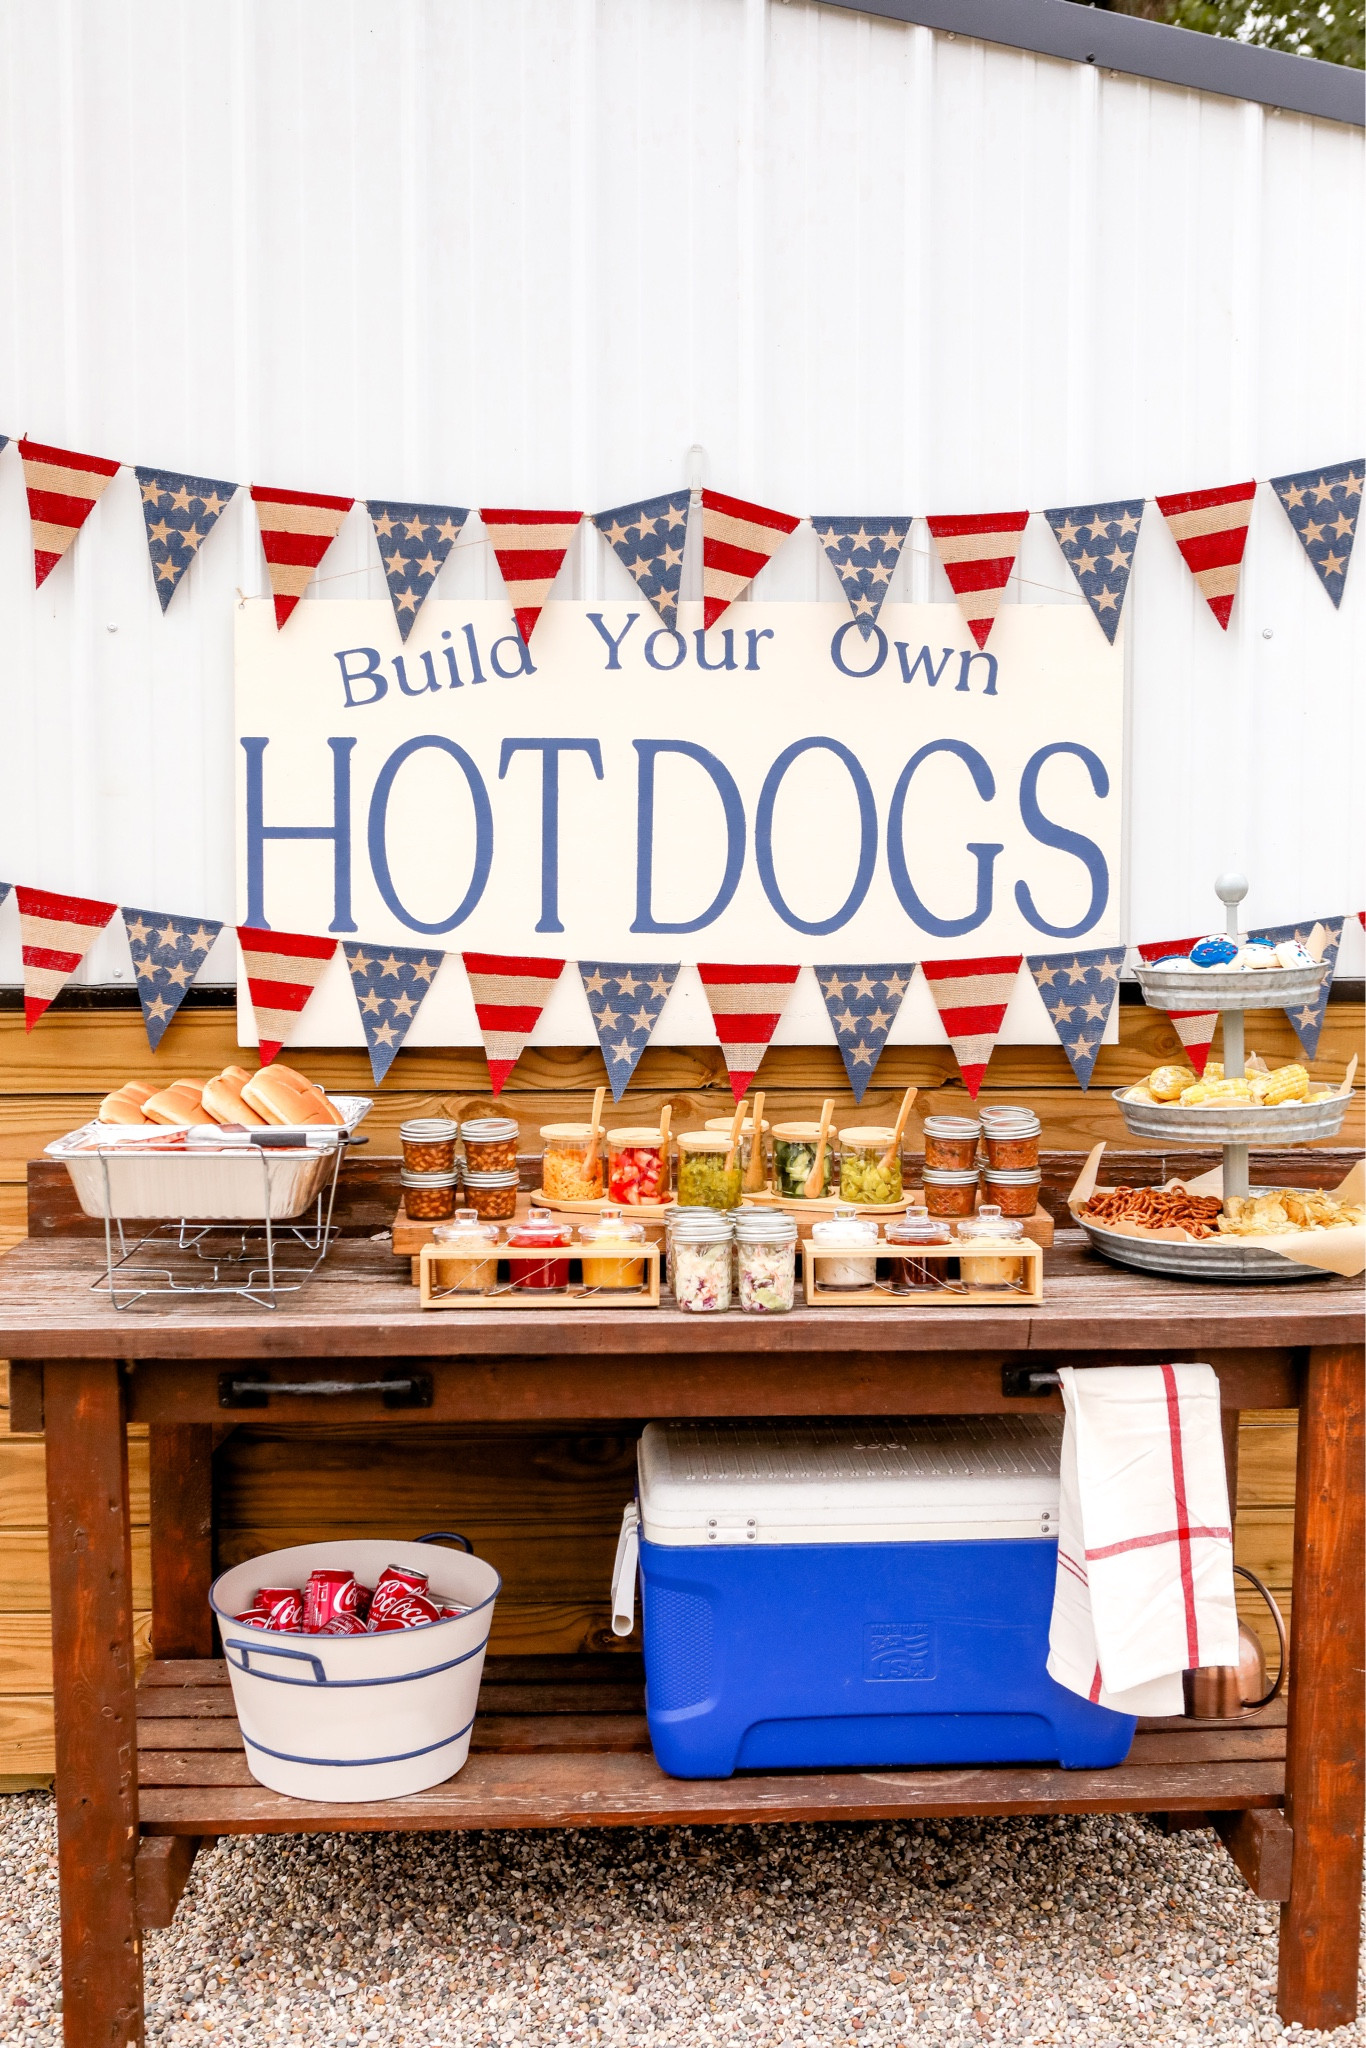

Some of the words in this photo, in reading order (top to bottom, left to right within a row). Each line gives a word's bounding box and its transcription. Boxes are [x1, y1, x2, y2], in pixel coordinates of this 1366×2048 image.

[334, 616, 538, 708] Build
[586, 612, 774, 671] Your
[830, 619, 998, 696] Own
